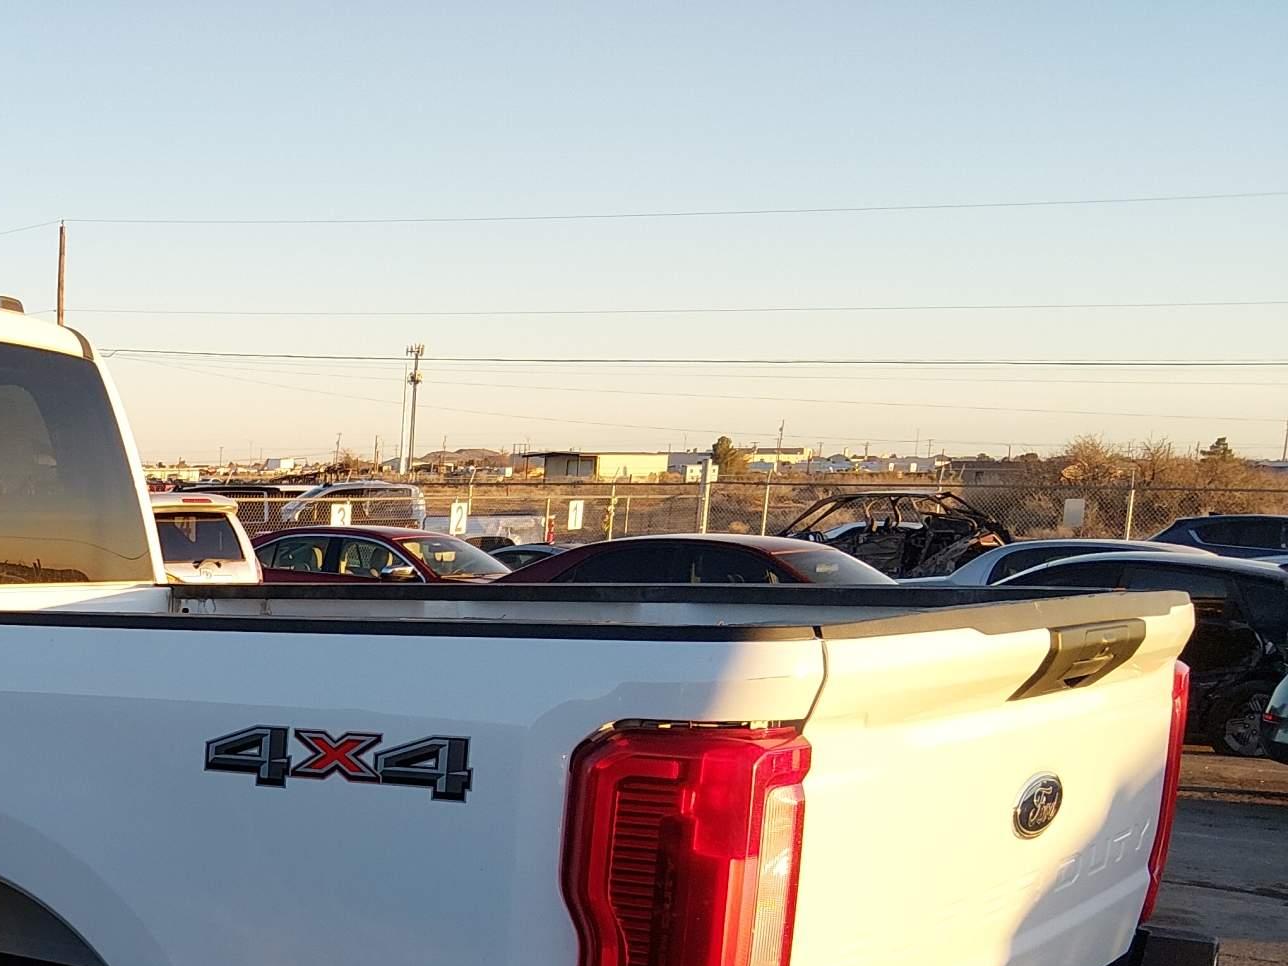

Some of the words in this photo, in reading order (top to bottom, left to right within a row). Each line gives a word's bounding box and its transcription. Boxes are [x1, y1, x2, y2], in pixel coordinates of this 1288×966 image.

[454, 505, 464, 532] 2
[572, 503, 578, 528] 1
[1052, 818, 1152, 893] DUTY
